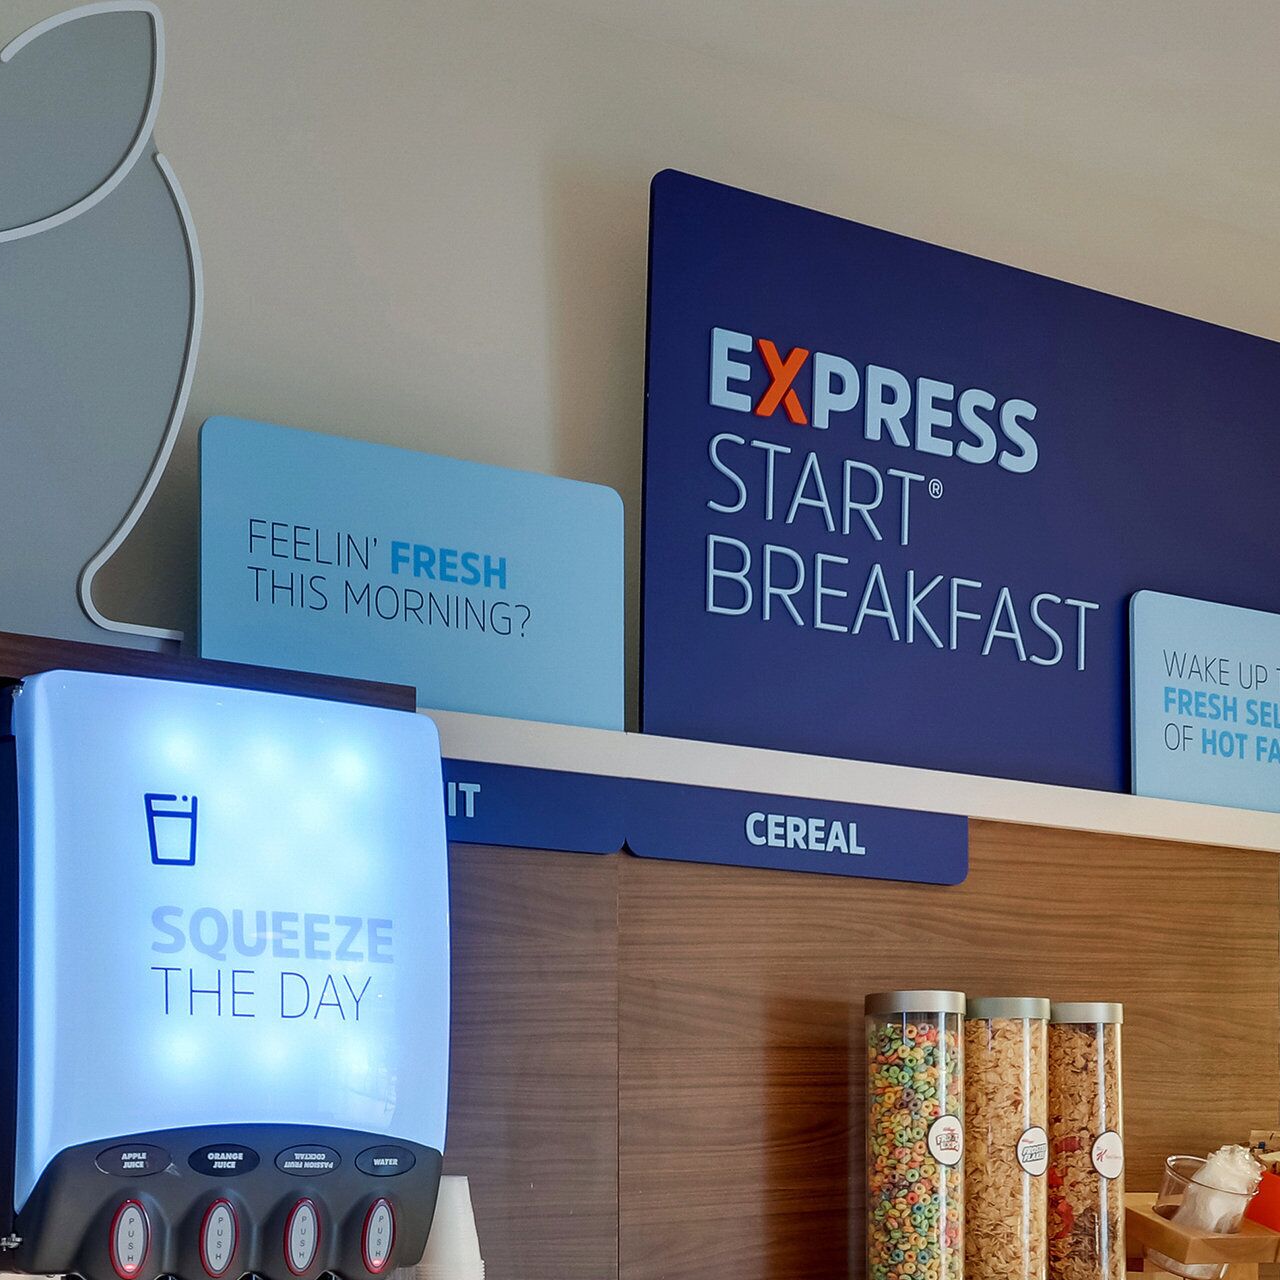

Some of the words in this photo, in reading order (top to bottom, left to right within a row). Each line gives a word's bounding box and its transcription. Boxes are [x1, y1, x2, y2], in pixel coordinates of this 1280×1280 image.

[710, 327, 1039, 473] EXPRESS
[248, 518, 378, 571] FEELIN'
[390, 541, 507, 590] FRESH
[247, 566, 329, 610] THIS
[344, 580, 531, 638] MORNING?
[705, 533, 1100, 671] BREAKFAST
[1163, 649, 1229, 686] WAKE
[1239, 661, 1268, 690] UP
[1163, 686, 1238, 723] FRESH
[1164, 722, 1193, 751] OF
[1201, 728, 1248, 759] HOT
[745, 811, 866, 855] CEREAL
[151, 905, 394, 964] SQUEEZE
[151, 966, 255, 1018] THE
[280, 971, 373, 1021] DAY
[121, 1152, 147, 1160] APPLE
[122, 1161, 144, 1169] JUICE
[207, 1152, 244, 1161] ORANGE
[212, 1161, 236, 1169] JUICE
[283, 1161, 303, 1169] FRUIT
[373, 1158, 398, 1166] WATER
[127, 1218, 135, 1262] PUSH
[215, 1217, 224, 1260] PUSH
[298, 1215, 307, 1259] PUSH
[375, 1215, 384, 1257] PUSH
